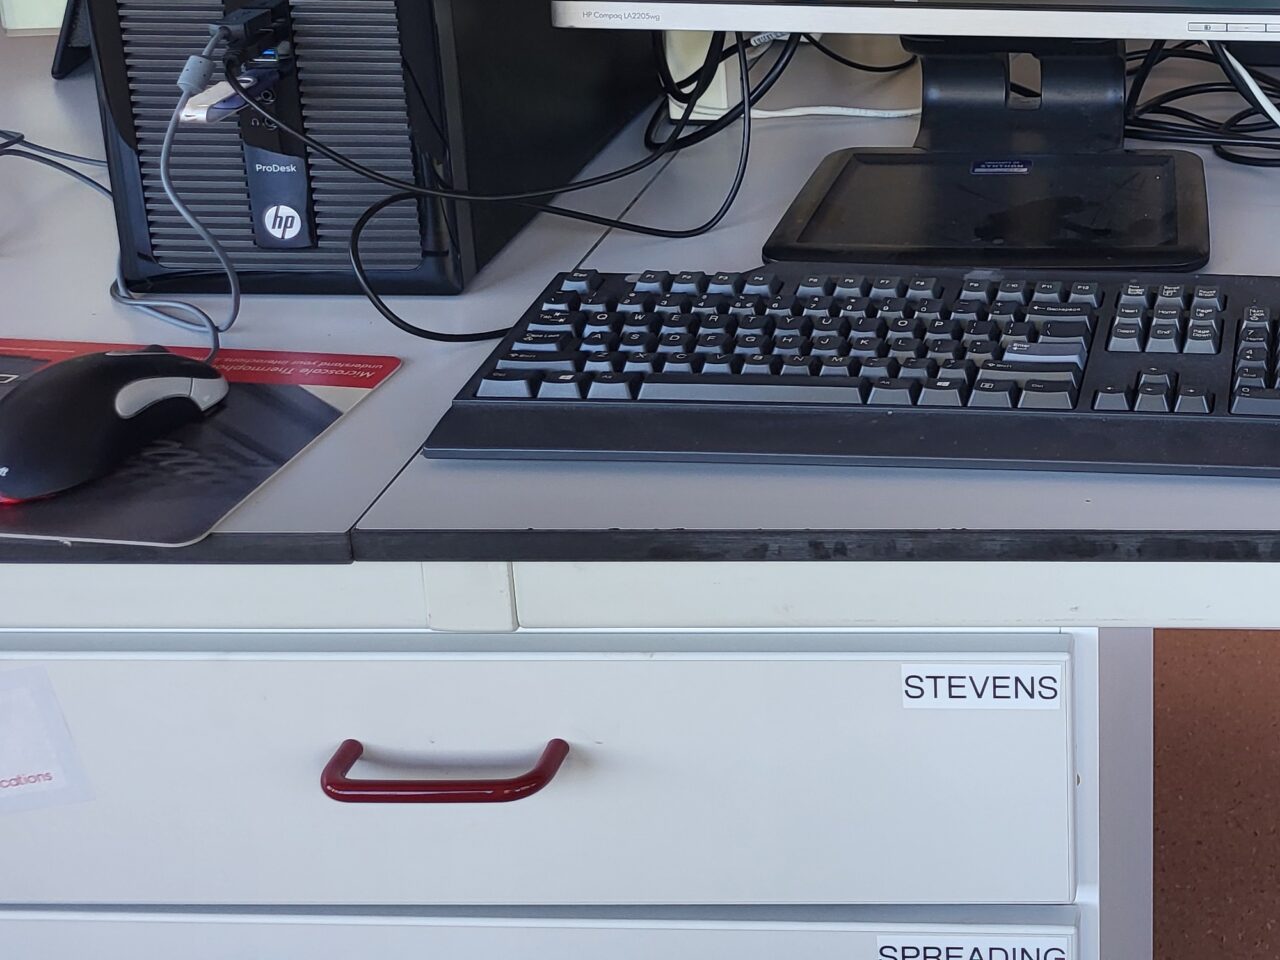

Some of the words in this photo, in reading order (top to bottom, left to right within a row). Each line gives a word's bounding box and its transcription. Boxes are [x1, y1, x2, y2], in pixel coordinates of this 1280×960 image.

[582, 11, 593, 19] HP
[594, 11, 622, 21] Compaq
[624, 12, 660, 21] LA2205wg
[256, 164, 296, 172] ProDesk
[300, 368, 375, 378] Microscale
[904, 675, 1058, 700] STEVENS
[879, 945, 1066, 960] SPREADING
